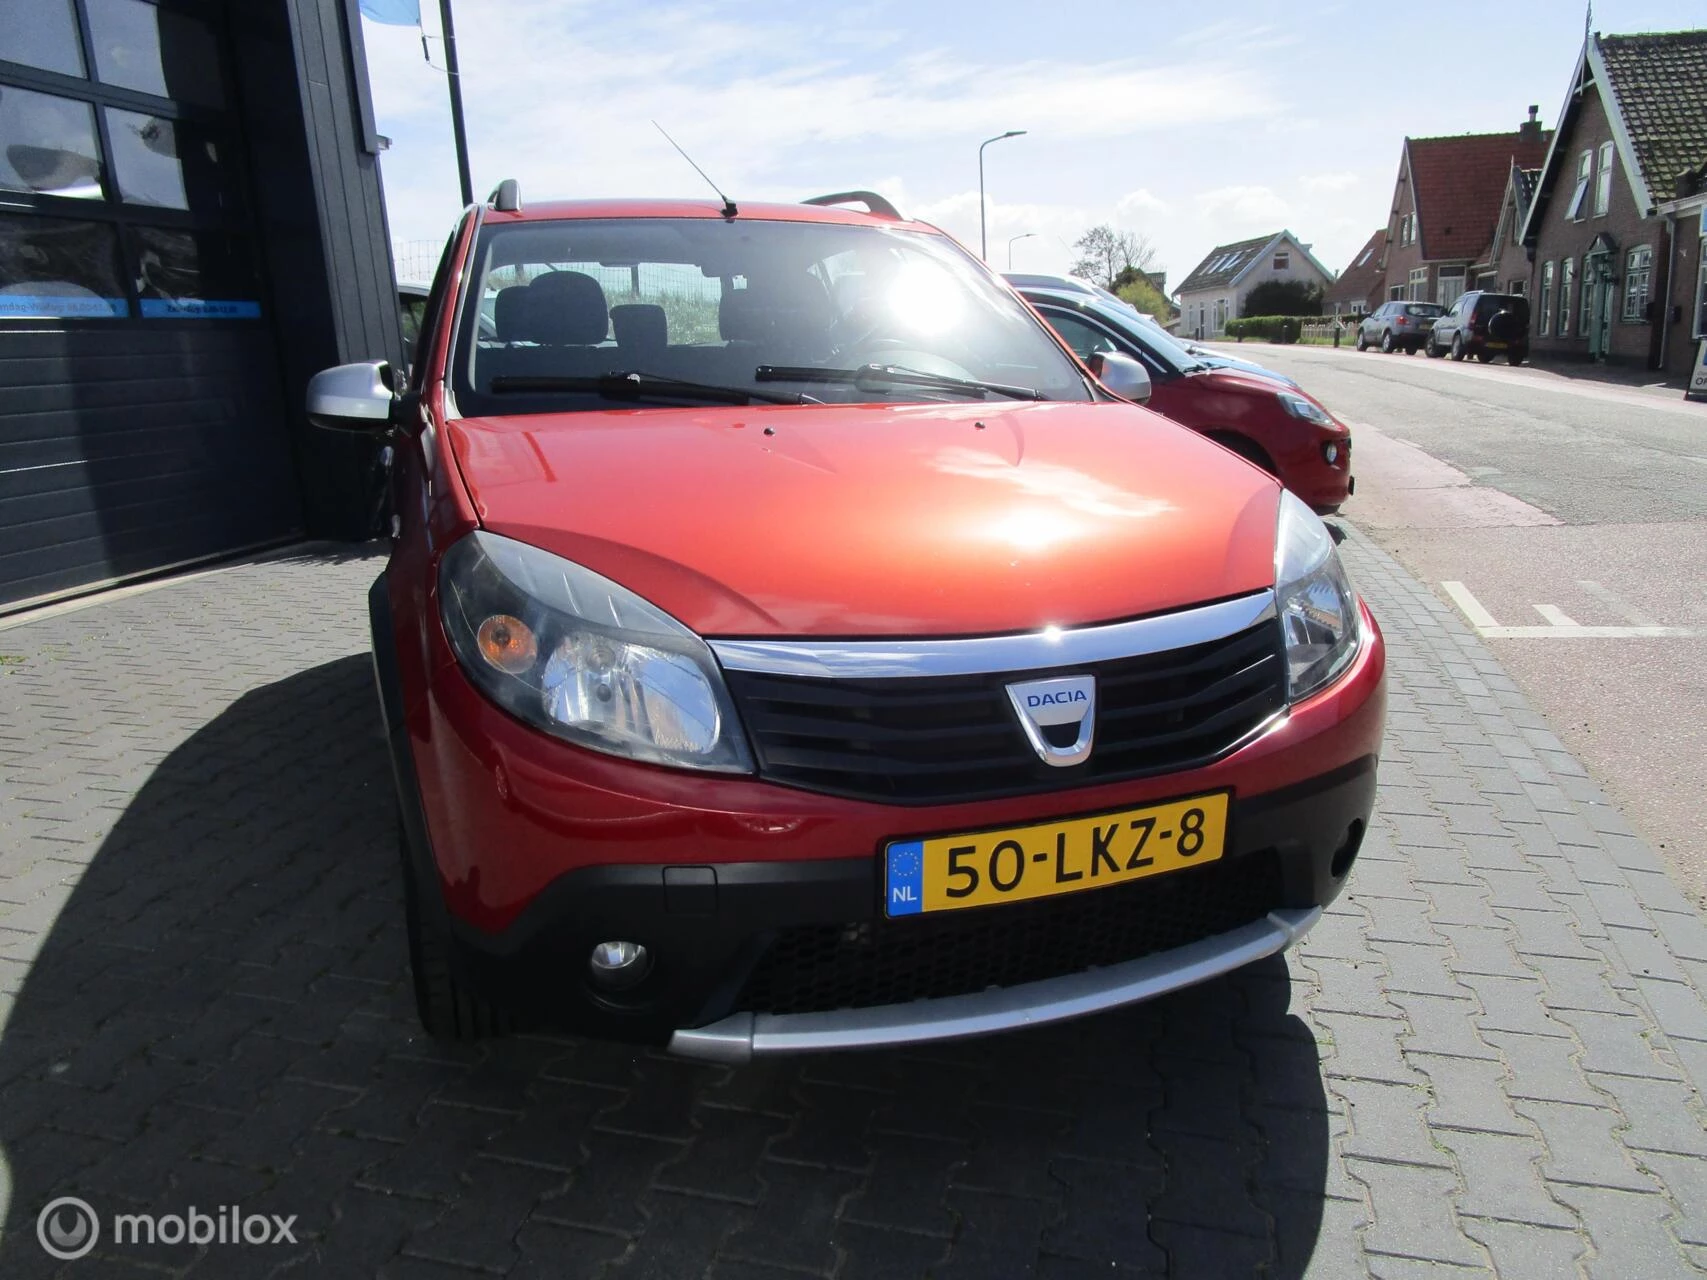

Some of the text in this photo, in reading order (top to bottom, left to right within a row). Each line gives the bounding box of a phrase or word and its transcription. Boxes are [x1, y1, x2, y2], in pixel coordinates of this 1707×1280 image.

[1027, 690, 1087, 707] DACIA
[892, 808, 1206, 903] NL 50-LKZ-8
